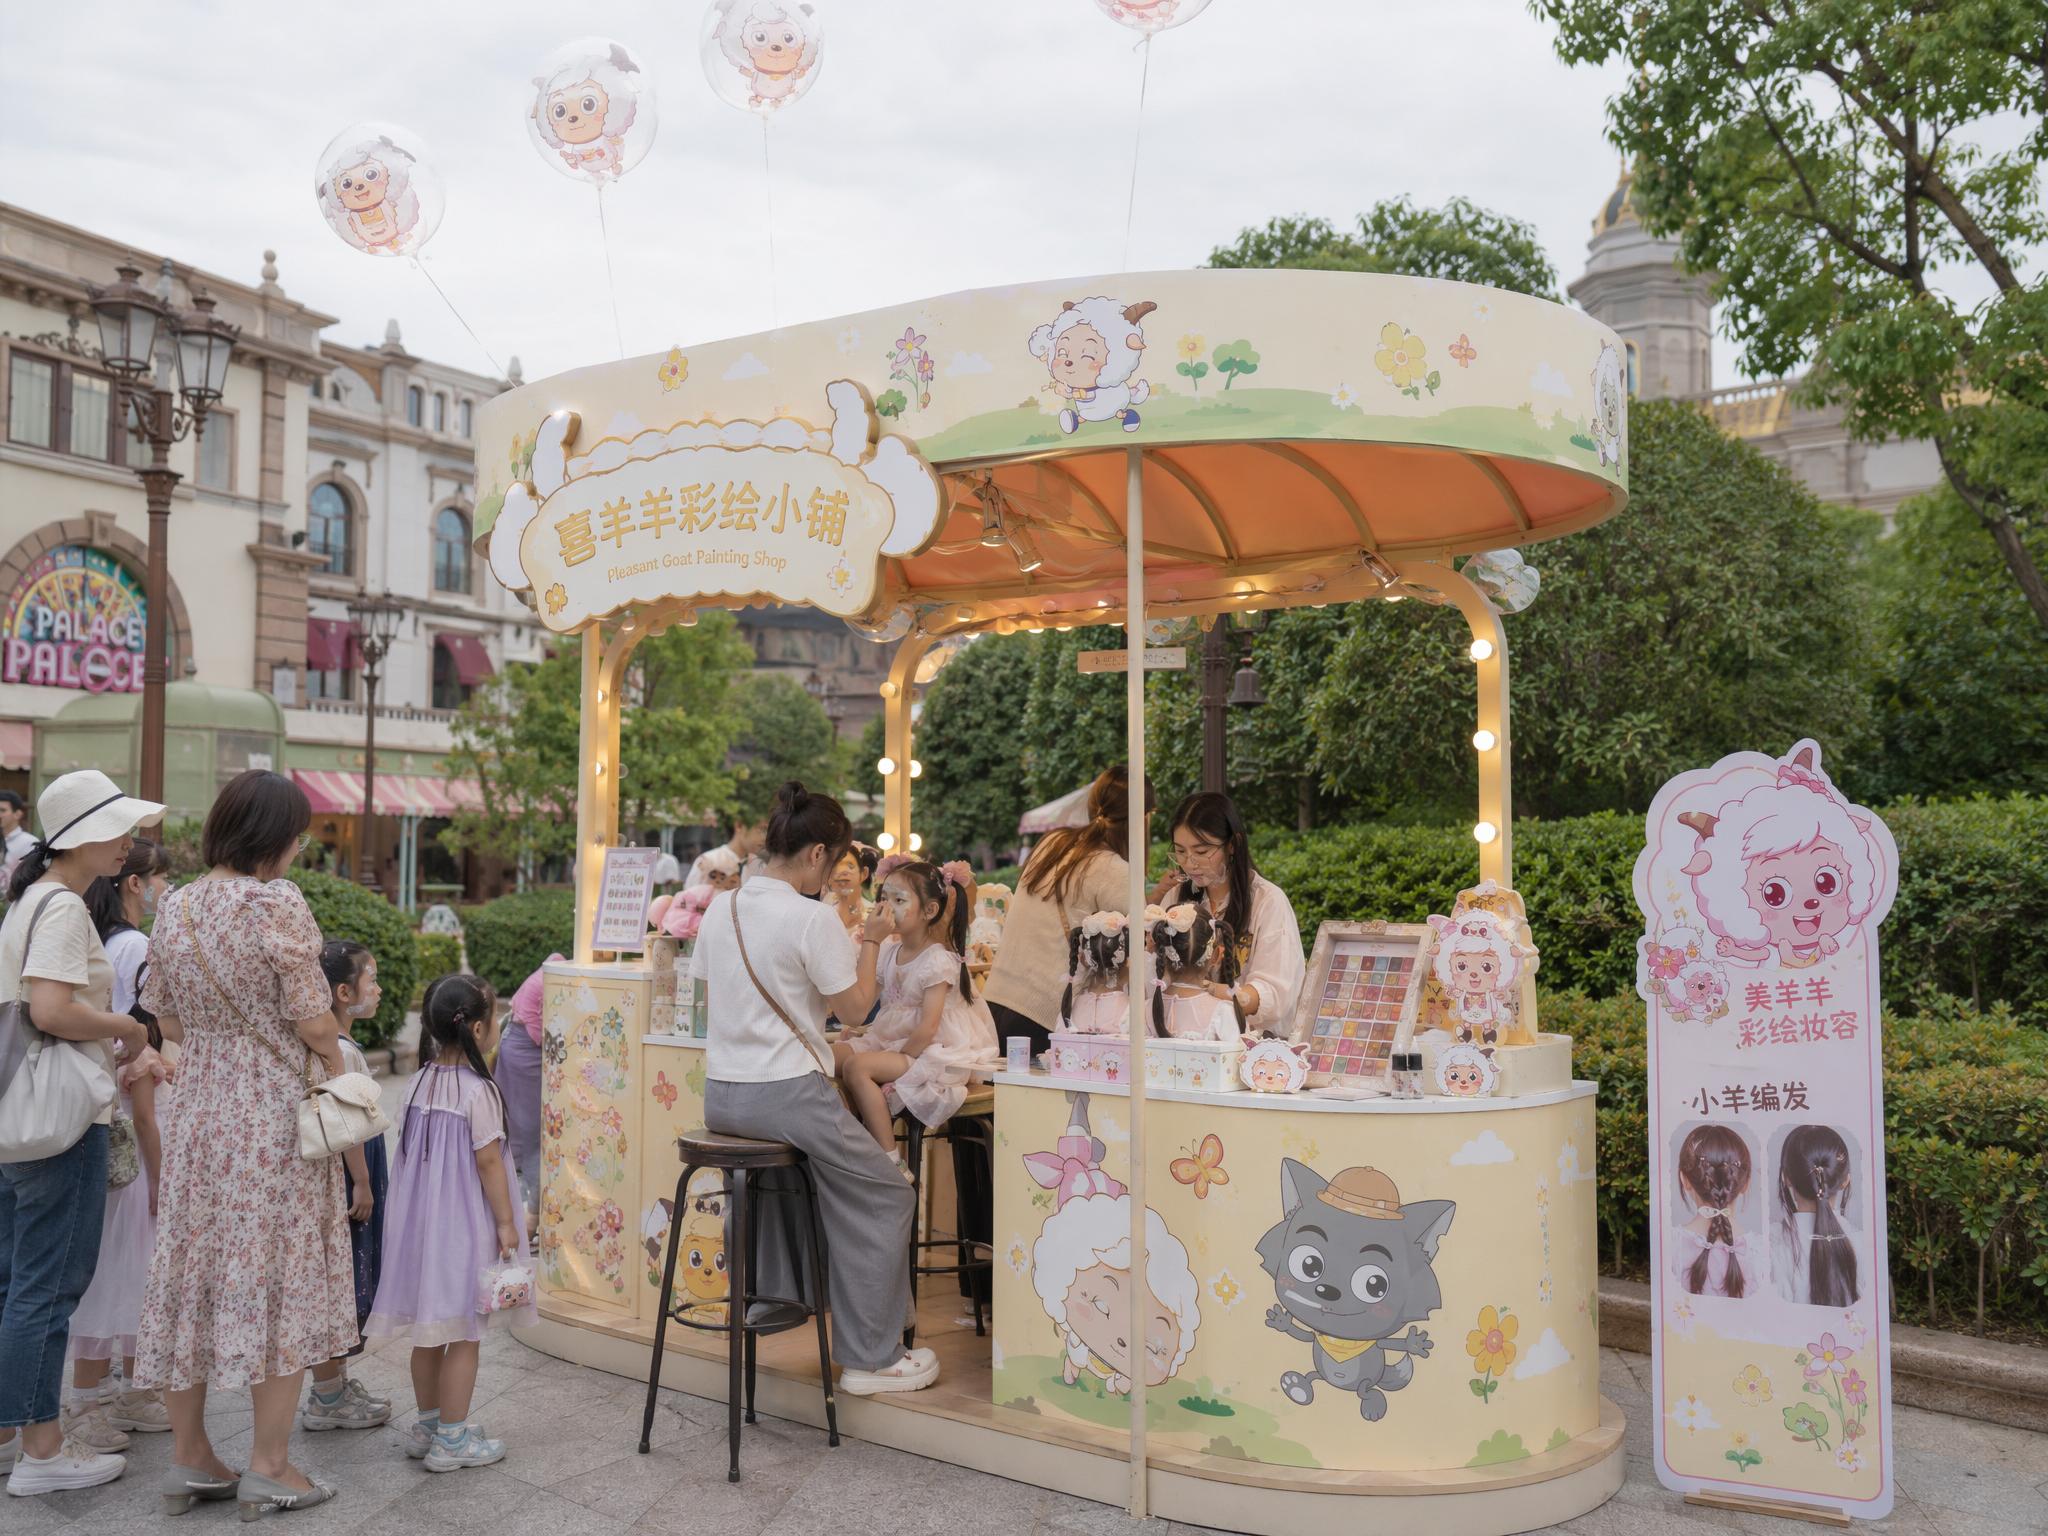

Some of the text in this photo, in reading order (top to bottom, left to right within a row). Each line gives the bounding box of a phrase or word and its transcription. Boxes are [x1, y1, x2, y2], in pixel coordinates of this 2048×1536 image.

[554, 480, 850, 568] 喜羊羊彩绘小铺
[608, 549, 787, 583] Pleasant Goat Painting Shop
[34, 606, 142, 648] PALACE
[1745, 976, 1834, 1012] 美羊羊
[1738, 1010, 1860, 1047] 彩绘妆容
[1691, 1081, 1810, 1115] 小羊编发
